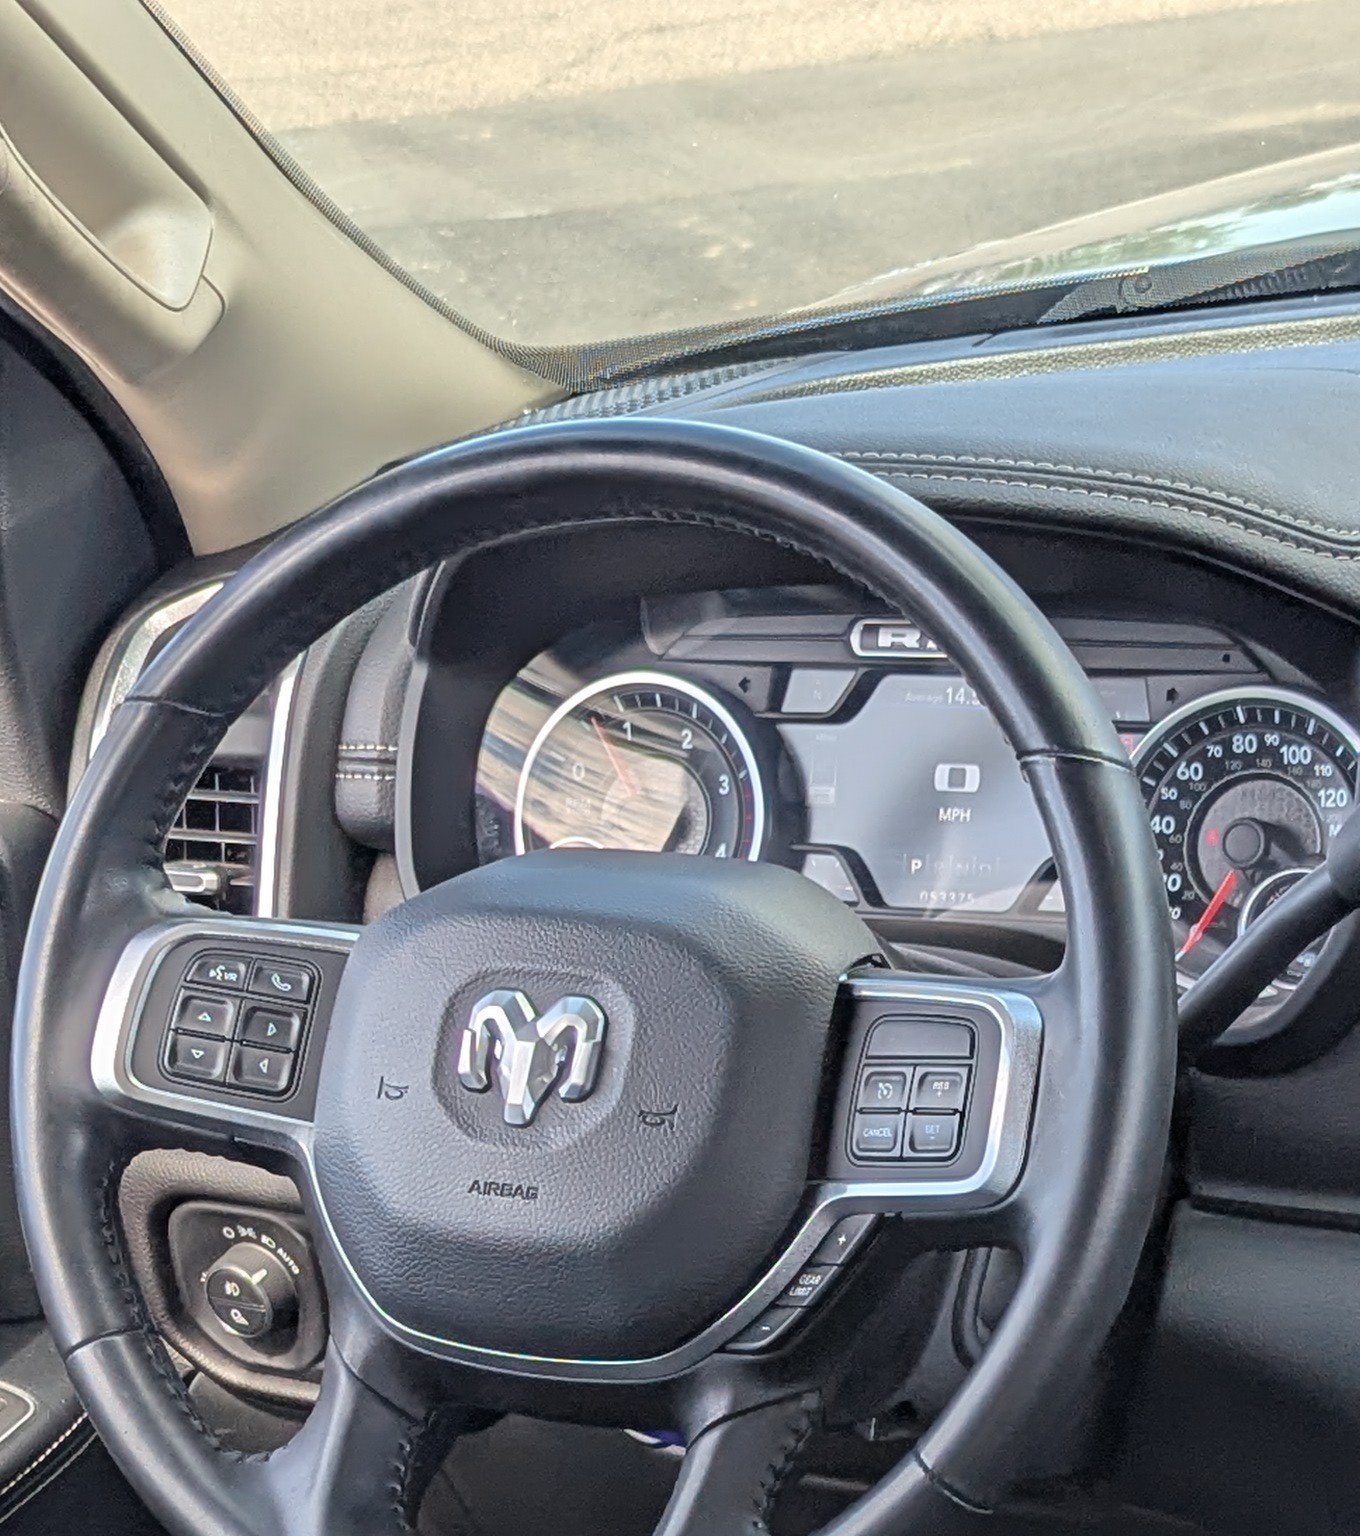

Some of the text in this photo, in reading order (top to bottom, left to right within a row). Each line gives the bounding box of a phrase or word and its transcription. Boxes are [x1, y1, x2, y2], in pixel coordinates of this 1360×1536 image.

[622, 722, 632, 741] 1
[681, 729, 693, 749] 2
[1264, 734, 1279, 746] 90
[1206, 745, 1223, 758] 70
[1232, 734, 1257, 754] 80
[1280, 746, 1311, 764] 100
[1176, 762, 1203, 781] 60
[1314, 765, 1332, 777] 110
[719, 774, 729, 795] 3
[1161, 787, 1178, 800] 50
[1318, 788, 1347, 807] 120
[939, 808, 971, 822] MPH
[1150, 815, 1175, 834] 40
[911, 858, 922, 874] P
[468, 1180, 538, 1200] AIRBAG
